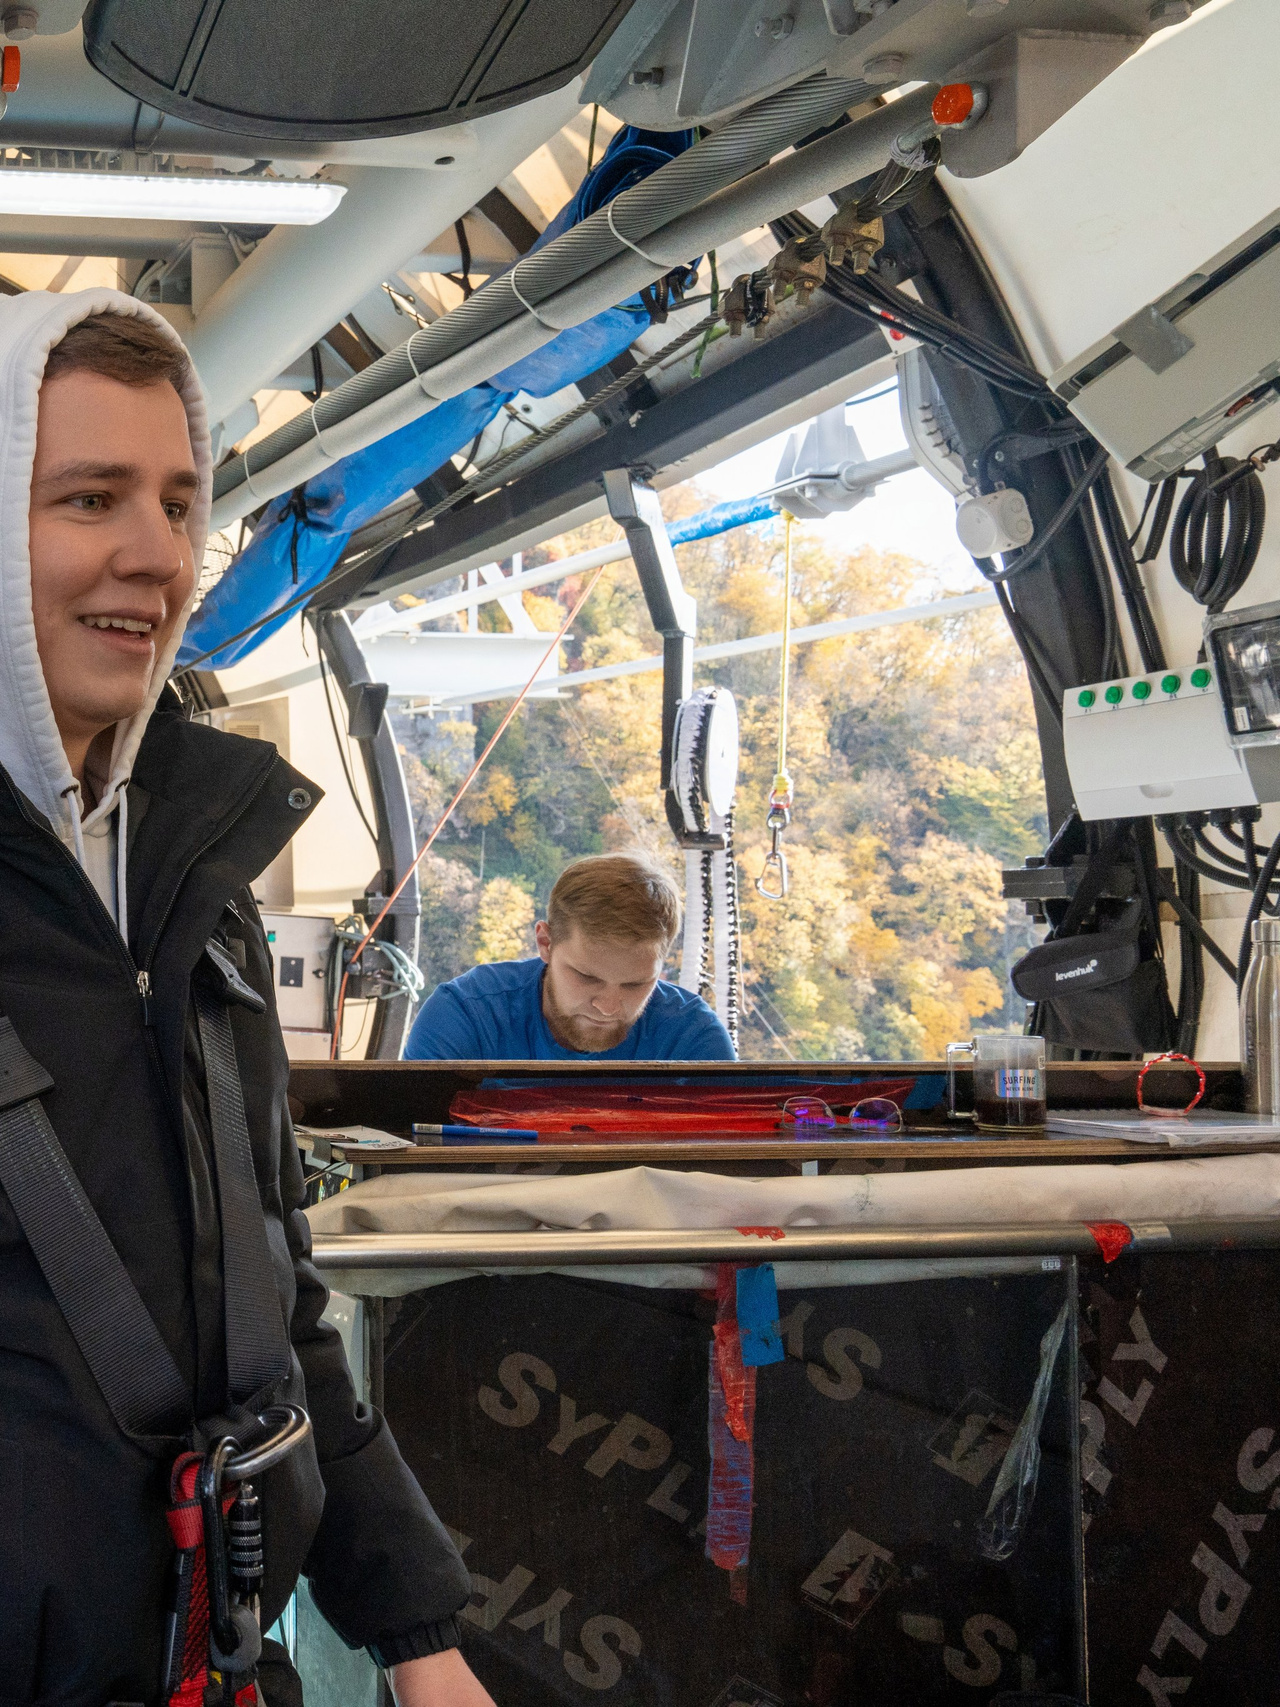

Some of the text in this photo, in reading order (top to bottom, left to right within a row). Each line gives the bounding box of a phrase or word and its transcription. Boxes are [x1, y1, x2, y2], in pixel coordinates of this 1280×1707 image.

[1055, 963, 1094, 982] levenhuk
[1002, 1075, 1037, 1085] SURFING
[477, 1351, 708, 1540] SYPL
